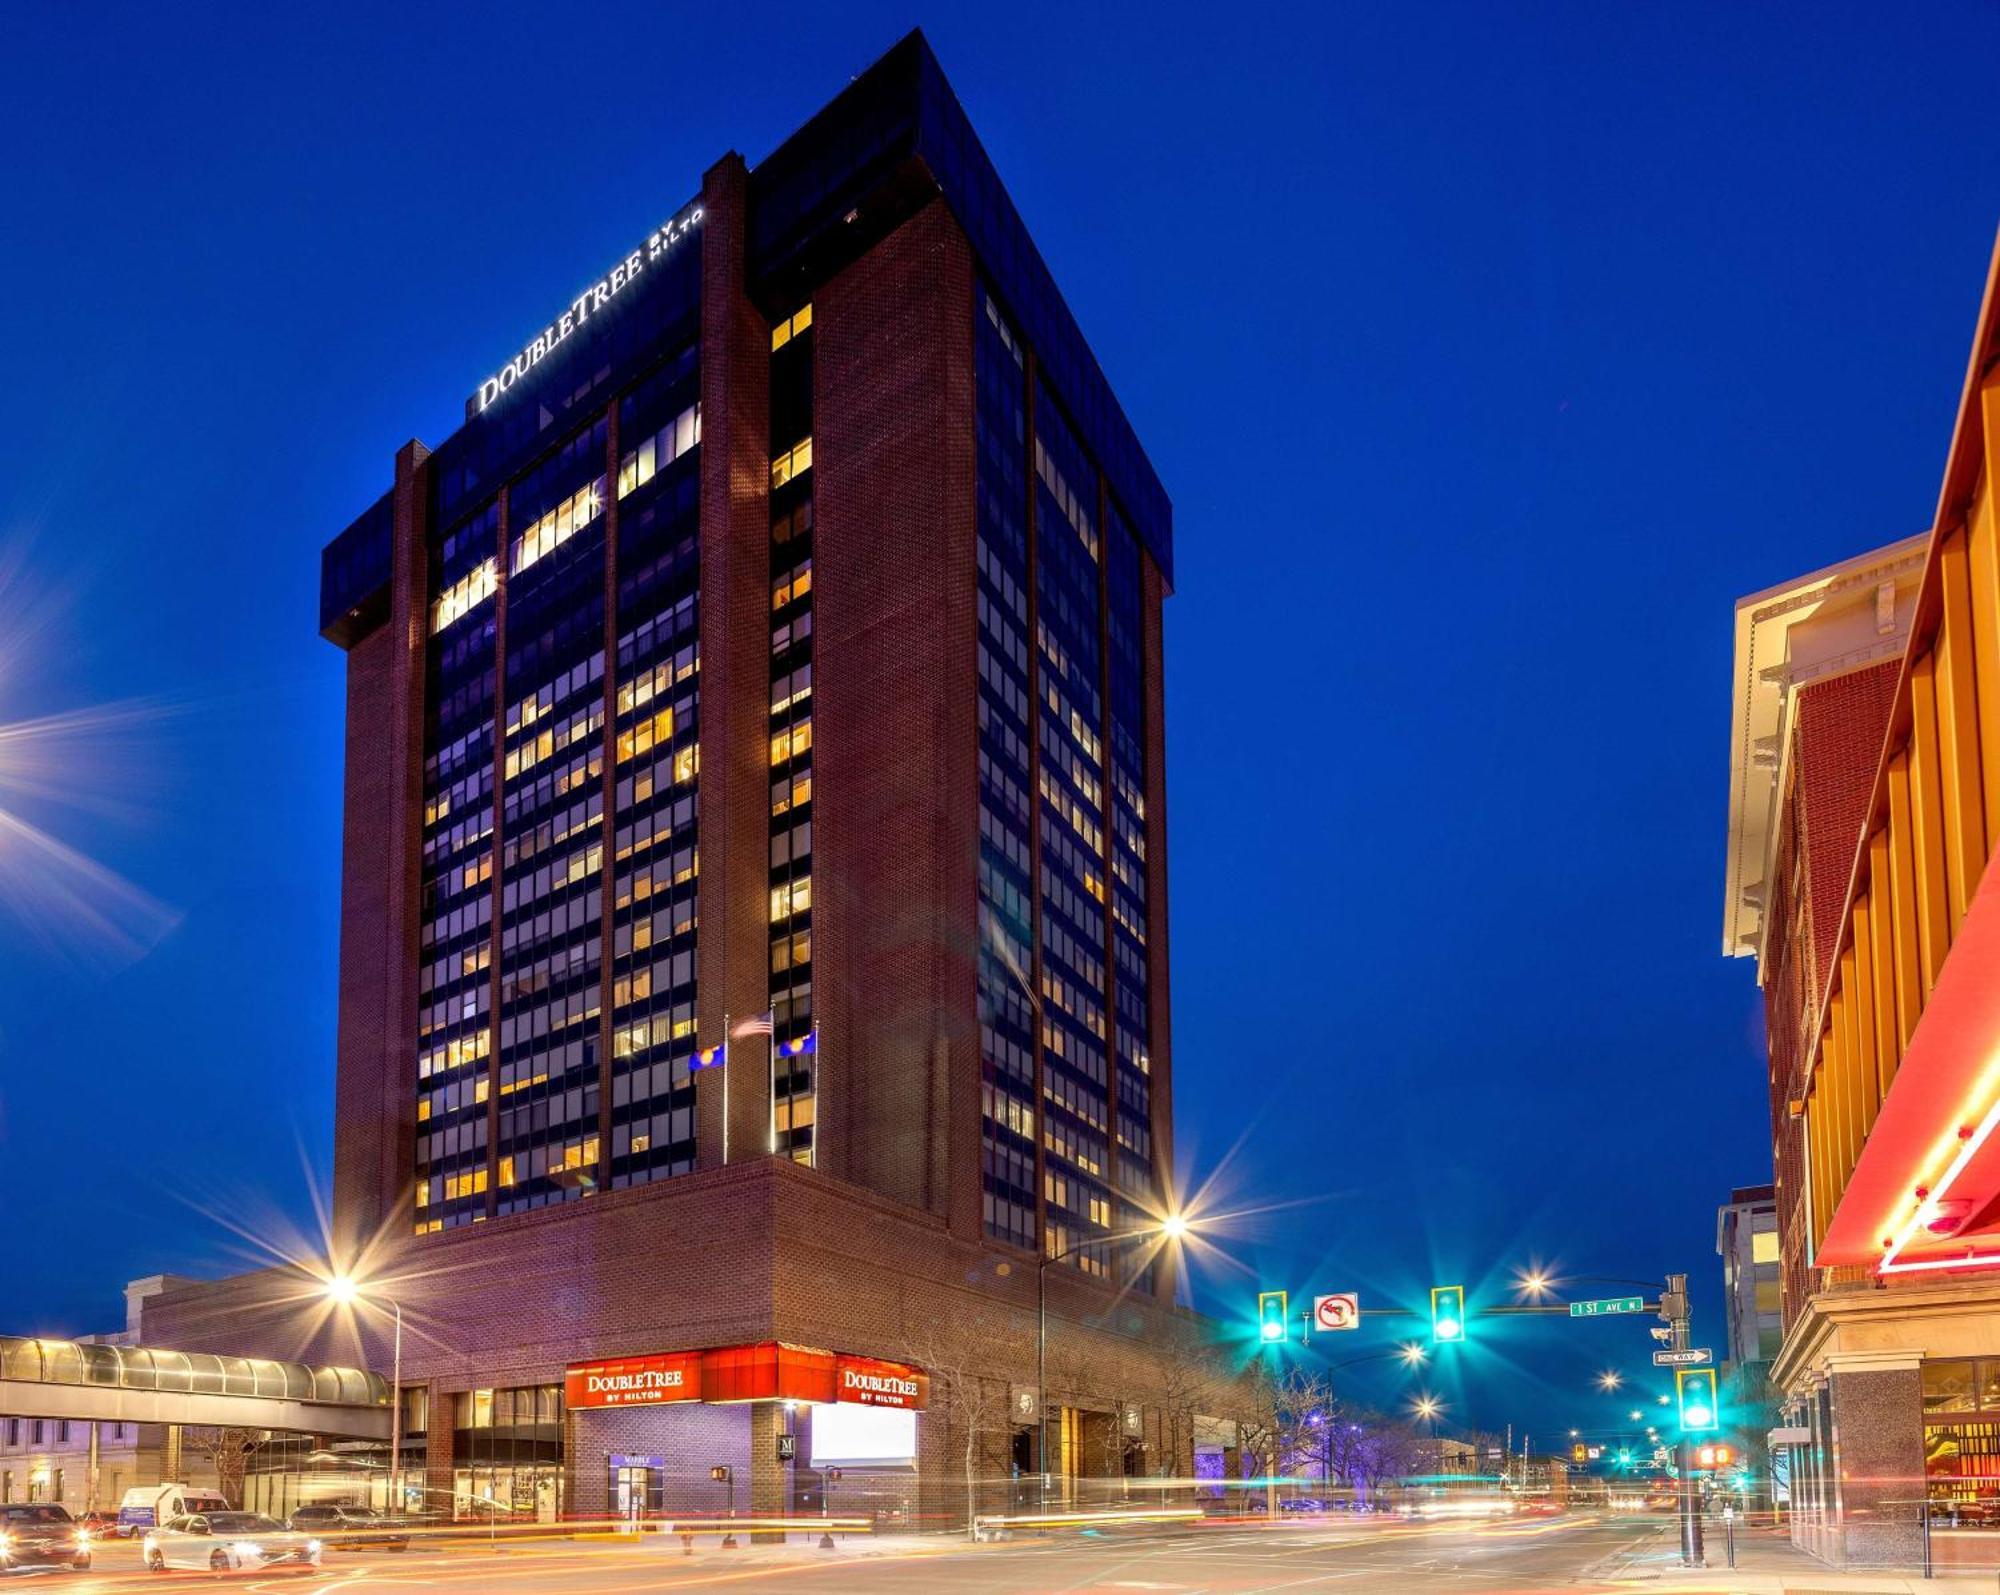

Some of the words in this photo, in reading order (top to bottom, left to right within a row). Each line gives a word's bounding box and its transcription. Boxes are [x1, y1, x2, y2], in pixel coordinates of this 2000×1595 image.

[650, 220, 673, 249] BY
[650, 209, 703, 261] HILTO
[479, 250, 643, 412] DOUBLETREE
[1606, 1301, 1621, 1312] AVE
[1629, 1301, 1636, 1309] N
[588, 1371, 683, 1392] DOUBLETREE
[845, 1370, 918, 1395] DOUBLETREE
[607, 1394, 619, 1402] BY
[624, 1391, 662, 1401] HILTON
[861, 1392, 872, 1401] BY
[875, 1394, 904, 1404] HILTON
[782, 1439, 792, 1451] M
